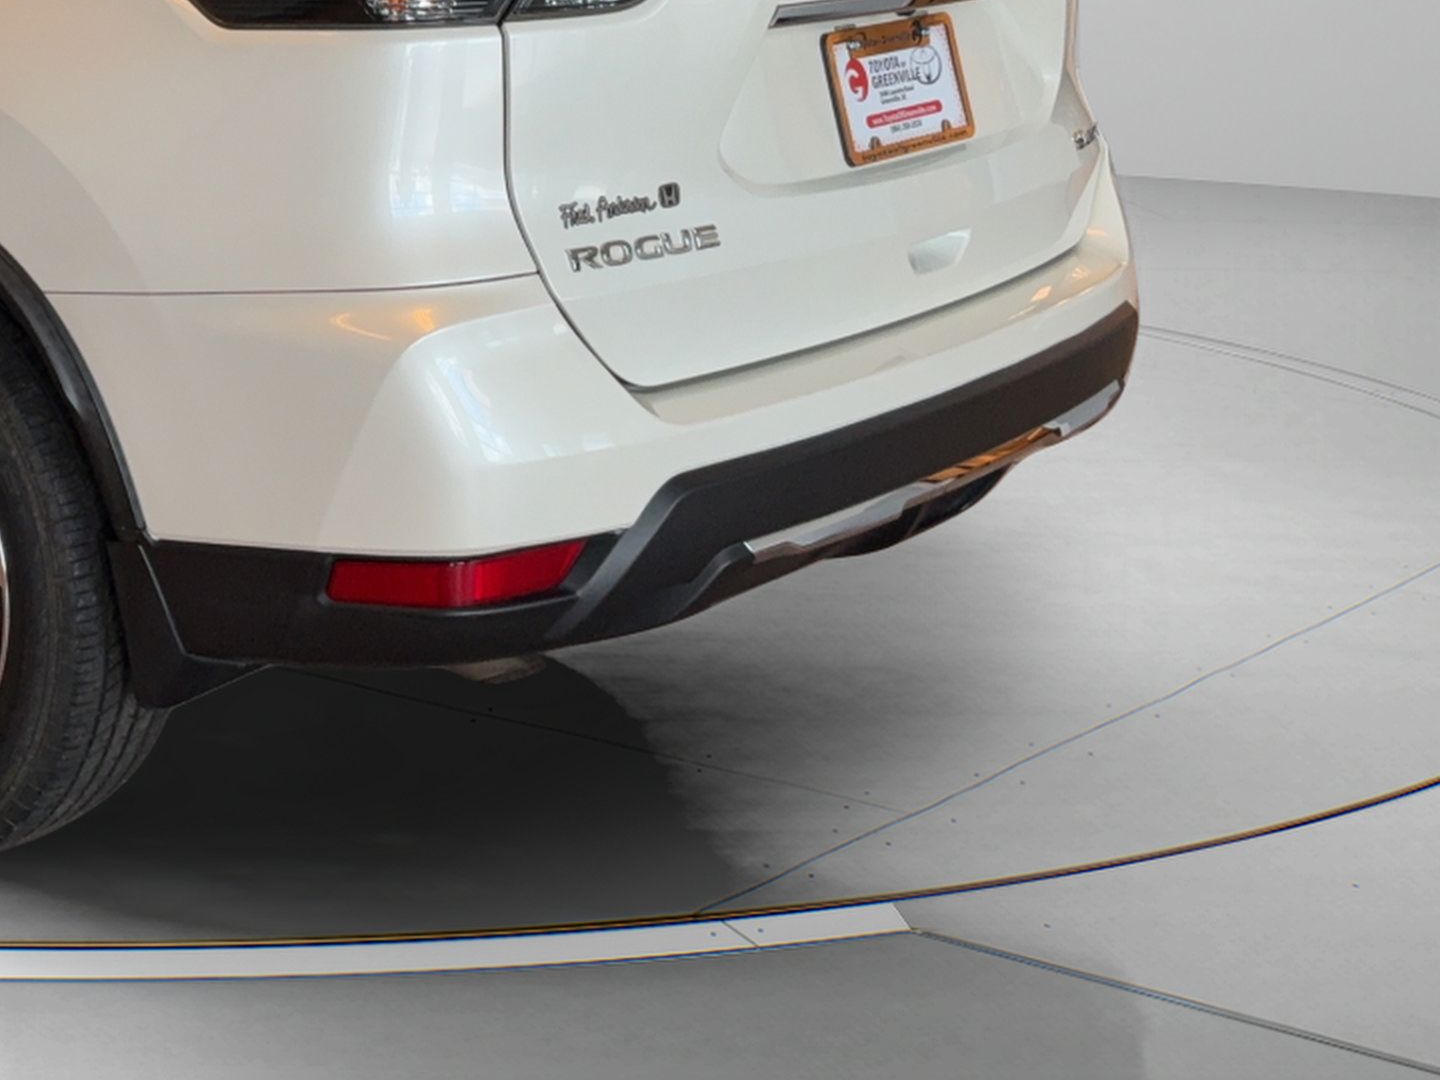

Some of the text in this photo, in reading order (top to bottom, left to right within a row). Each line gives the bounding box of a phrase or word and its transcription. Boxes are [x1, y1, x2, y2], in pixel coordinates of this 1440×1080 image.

[868, 56, 900, 74] TOYOTA
[871, 67, 921, 89] GREENVILLE
[565, 224, 721, 272] ROGUE
